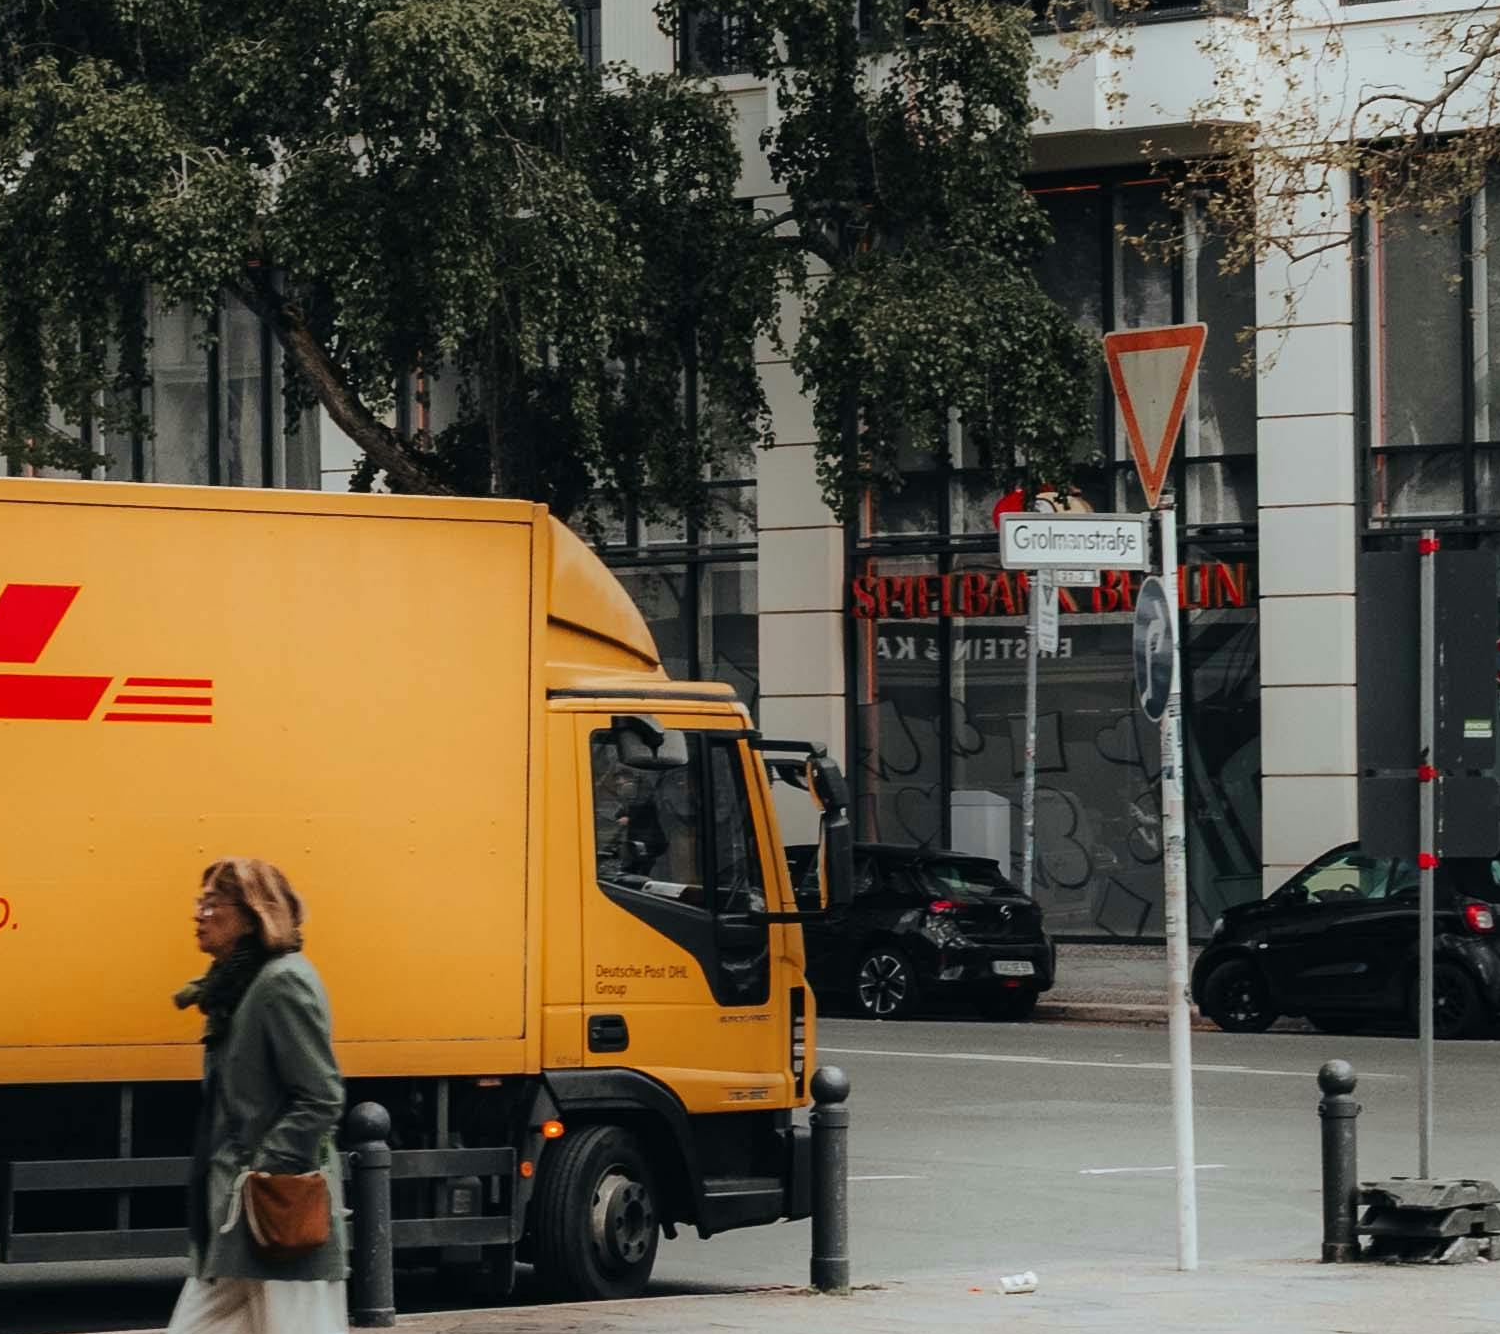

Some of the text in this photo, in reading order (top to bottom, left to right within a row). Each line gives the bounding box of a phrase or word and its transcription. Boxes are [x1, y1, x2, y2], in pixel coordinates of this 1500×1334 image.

[1012, 524, 1137, 557] Grolmanstraße
[852, 562, 1244, 619] SPIELBA BELIN
[595, 964, 689, 979] Deutsche Post DHL
[595, 981, 627, 997] Group
